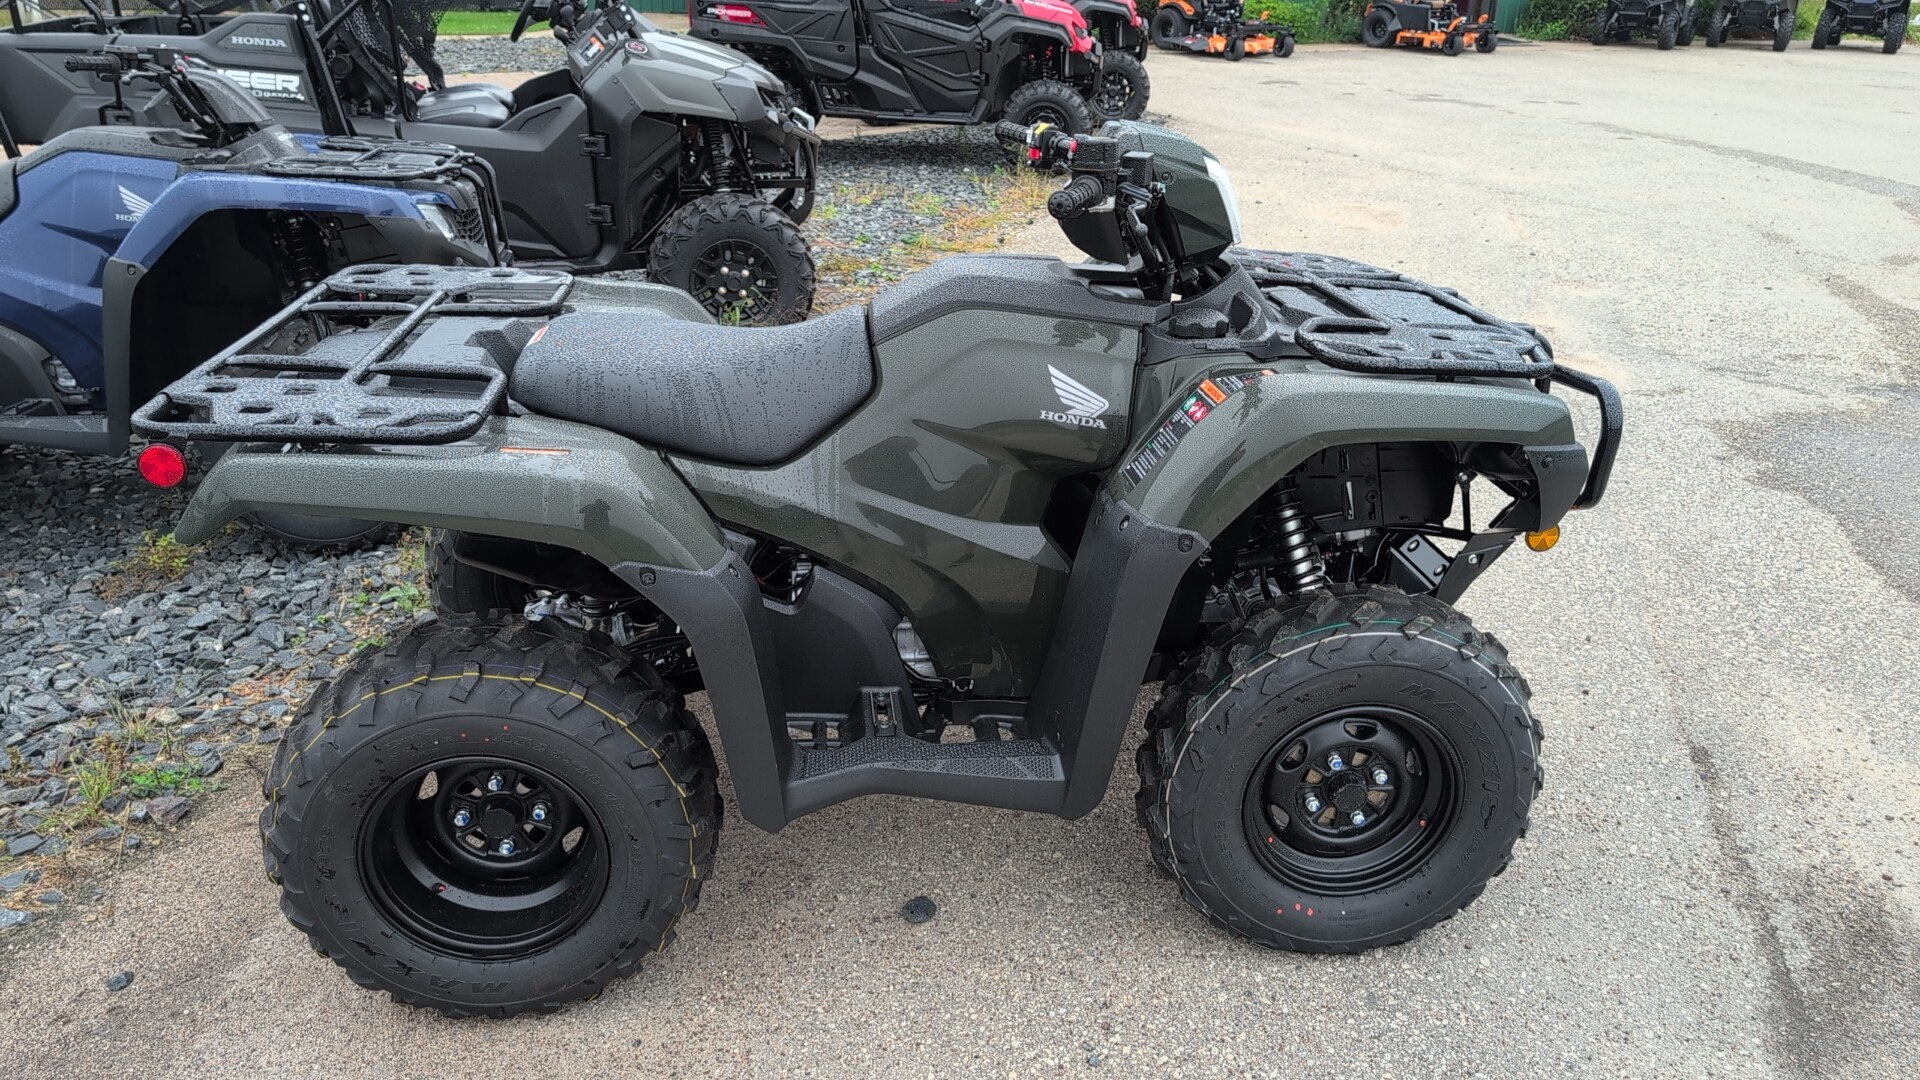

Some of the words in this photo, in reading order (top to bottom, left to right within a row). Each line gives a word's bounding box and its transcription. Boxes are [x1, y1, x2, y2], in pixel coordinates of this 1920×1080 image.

[231, 36, 288, 47] HONDA
[1039, 410, 1107, 430] HONDA
[1394, 682, 1502, 823] MAXXIS
